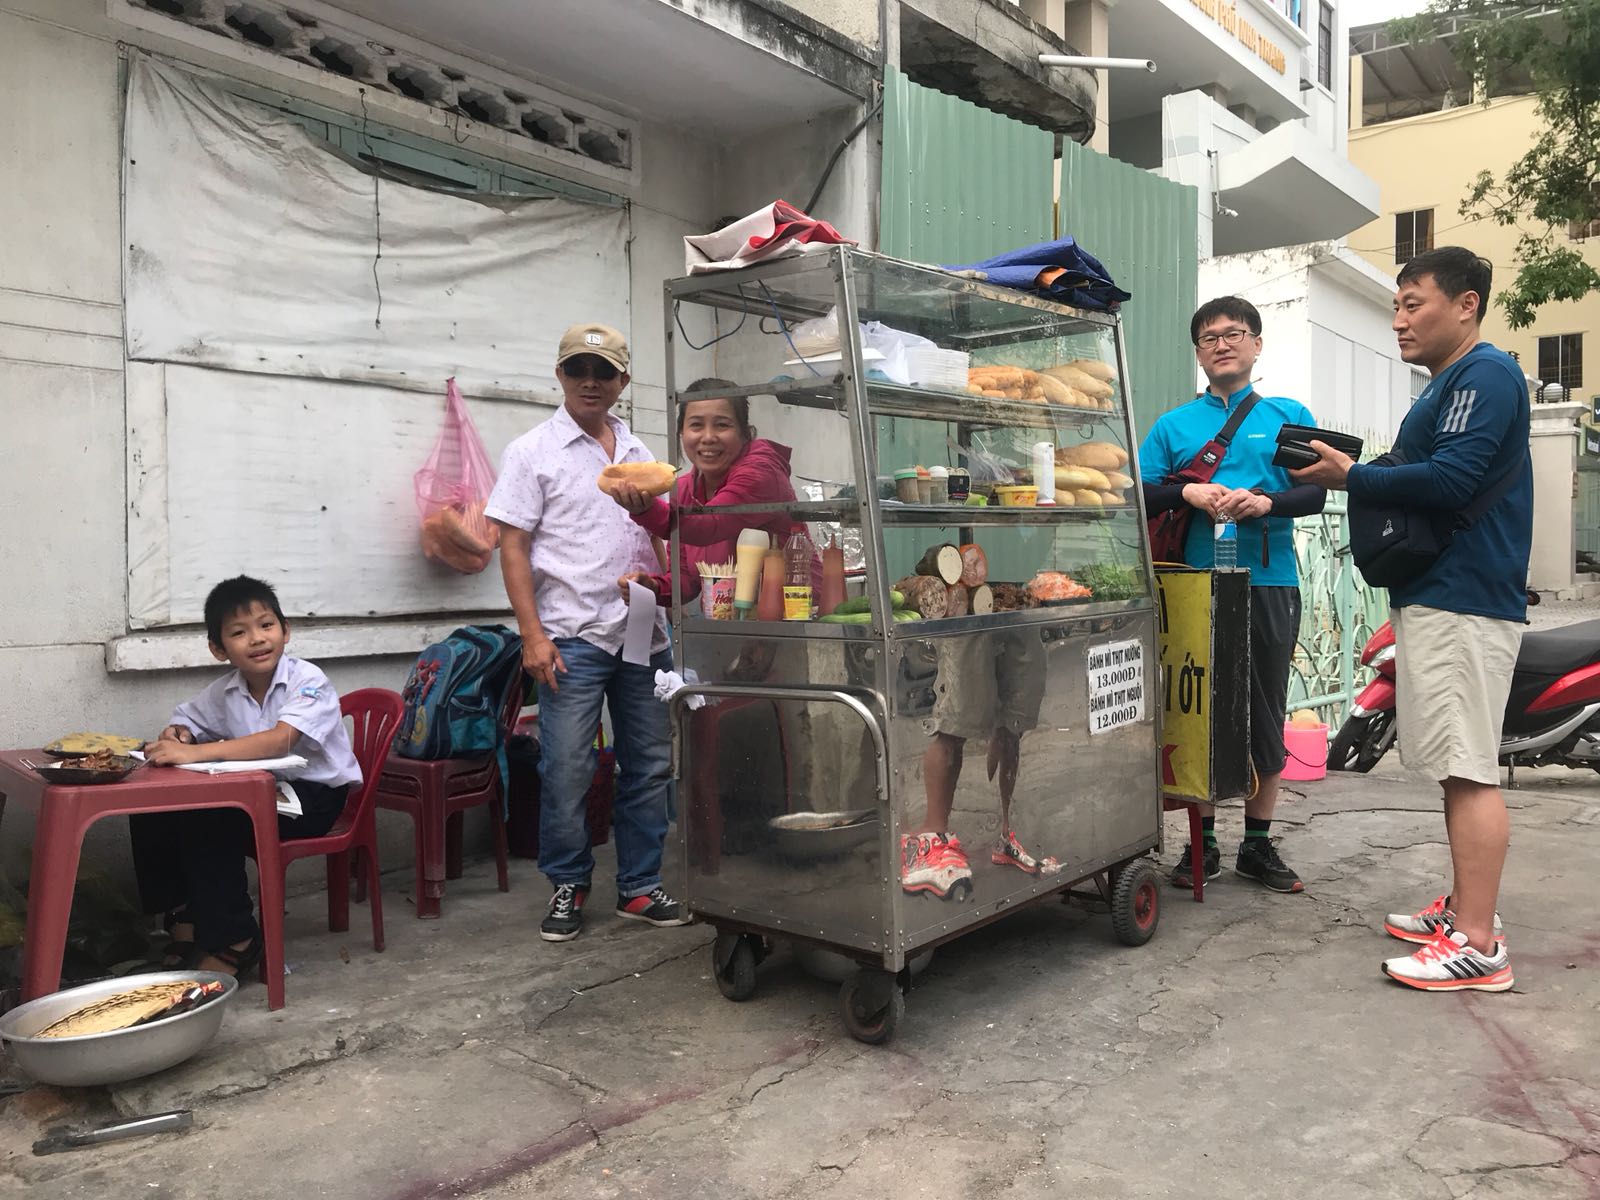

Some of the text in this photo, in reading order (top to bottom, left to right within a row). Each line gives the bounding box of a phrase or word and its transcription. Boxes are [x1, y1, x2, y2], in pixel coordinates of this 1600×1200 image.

[1090, 652, 1104, 670] BÁNH
[1112, 649, 1123, 667] THỊT
[1097, 667, 1136, 689] 13.000Đ
[1091, 693, 1105, 712] BÁNH
[1114, 690, 1126, 707] THỊT
[1097, 706, 1137, 729] 12.000Đ
